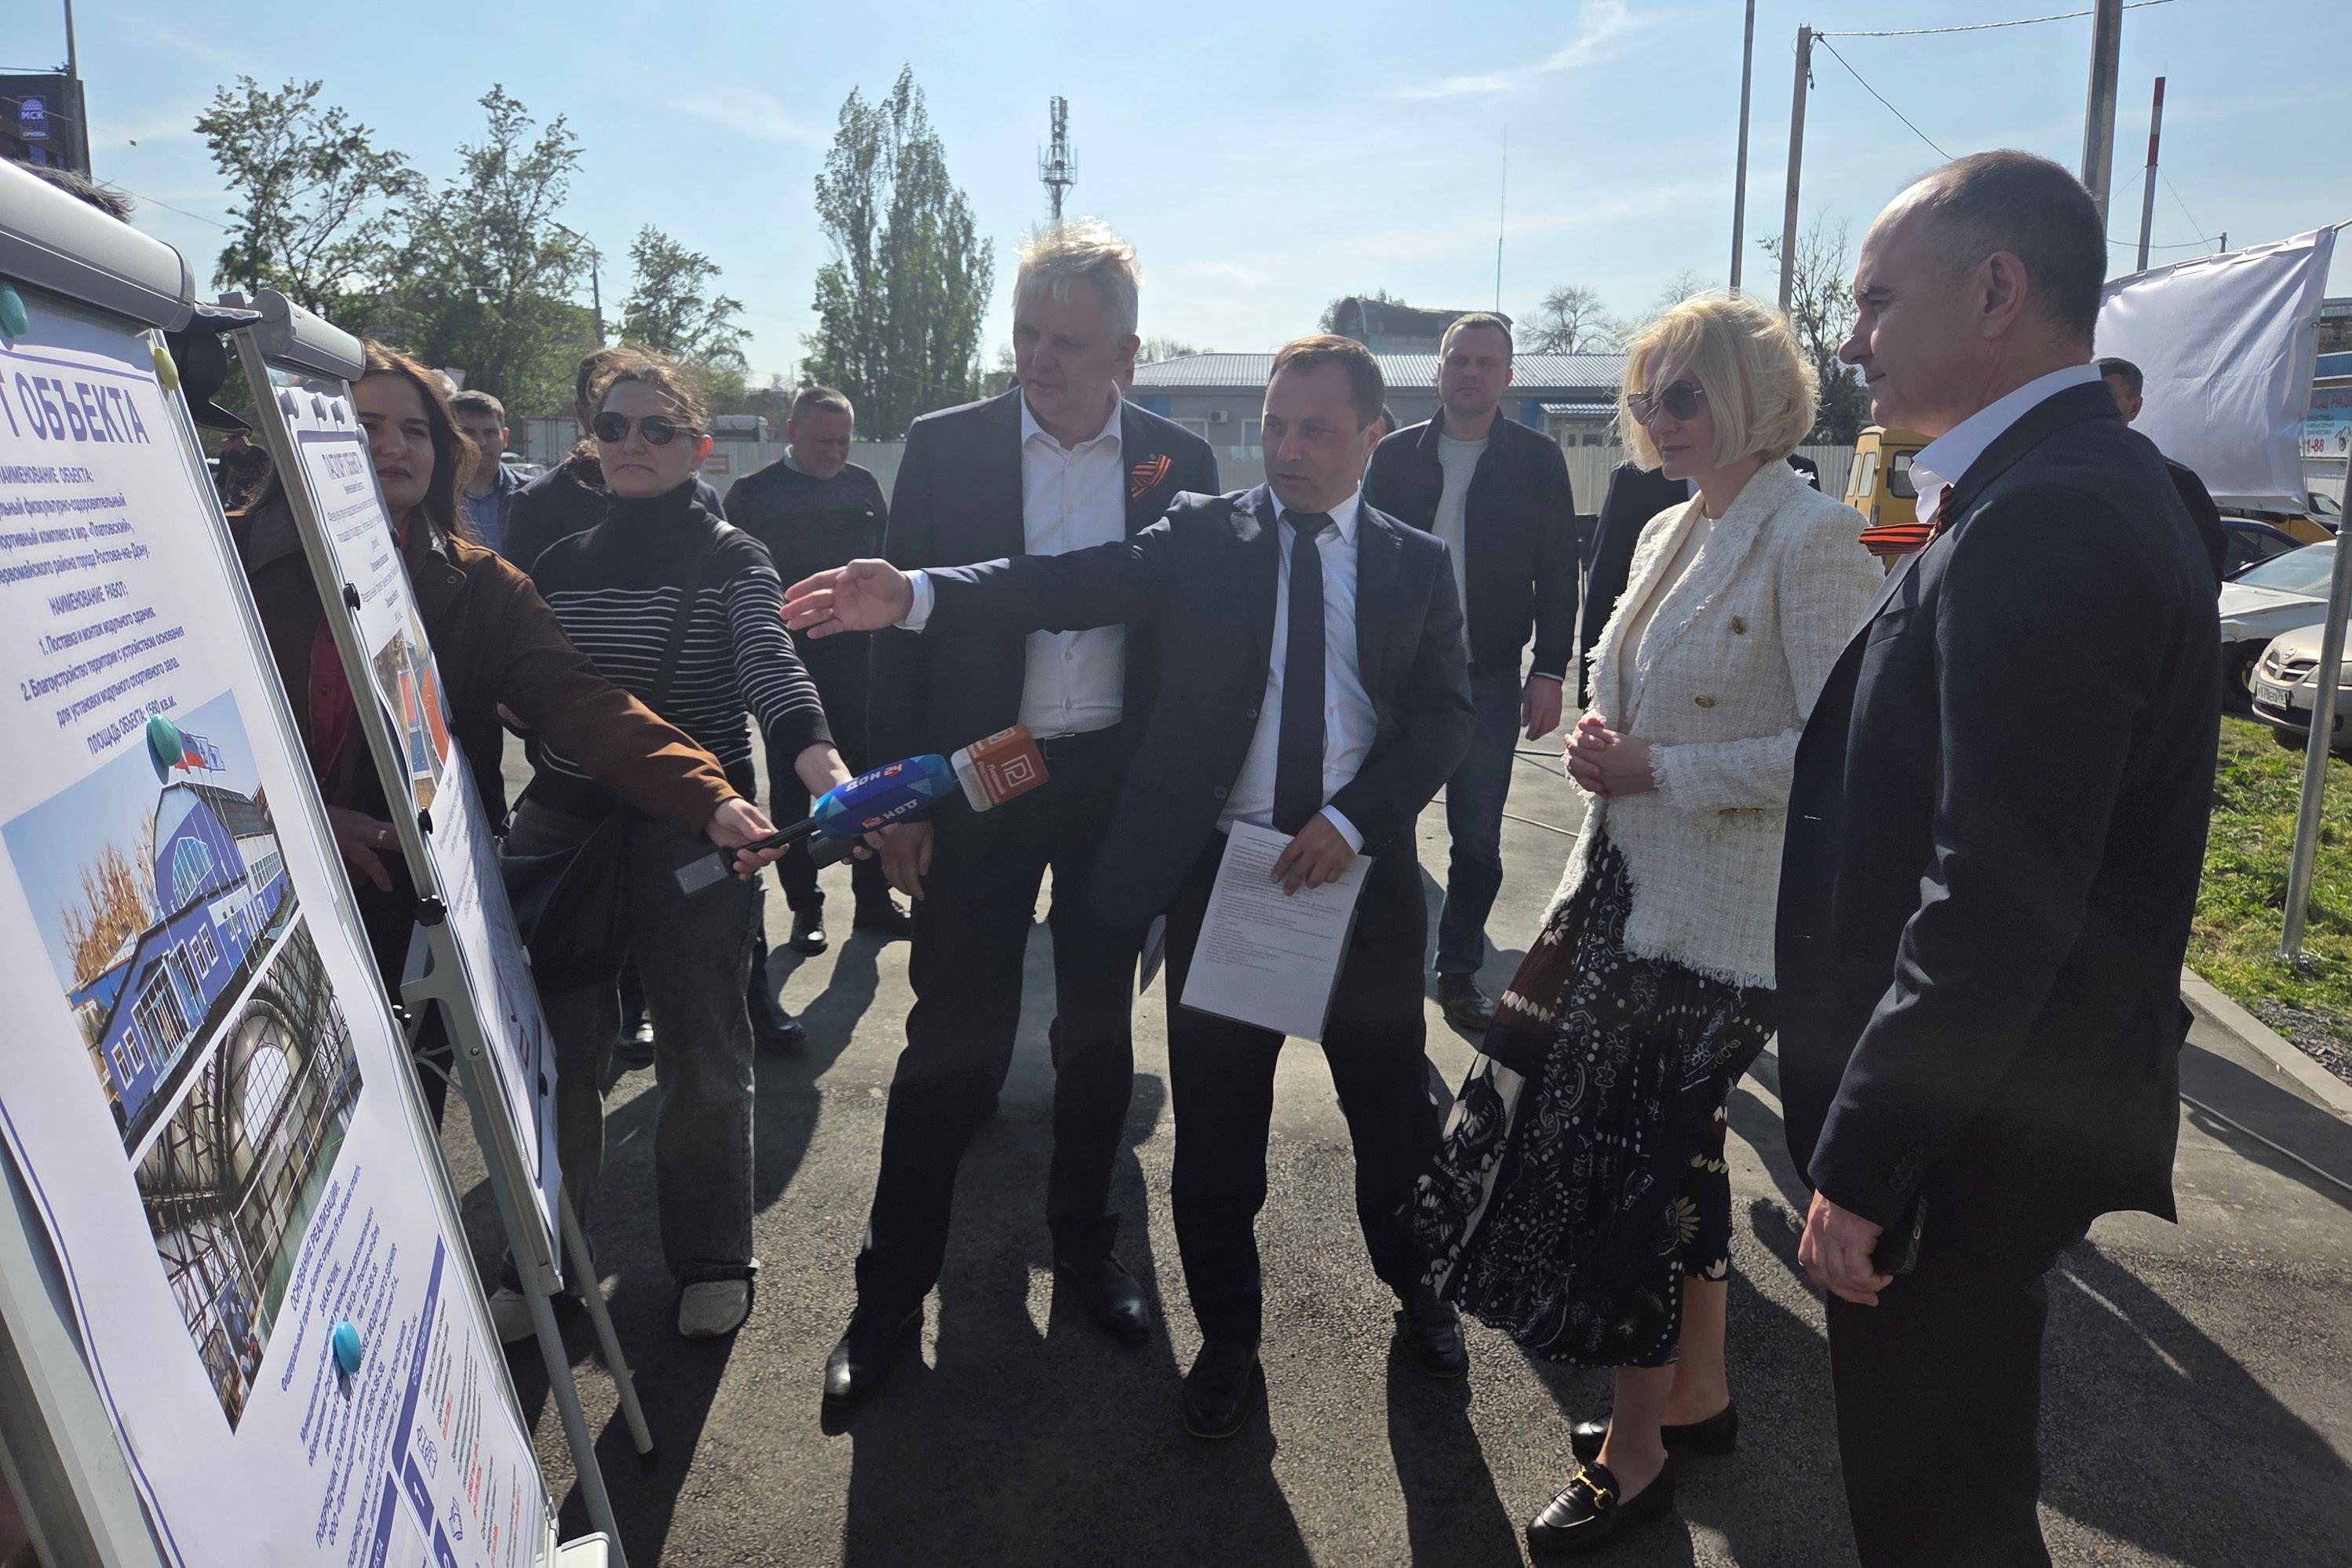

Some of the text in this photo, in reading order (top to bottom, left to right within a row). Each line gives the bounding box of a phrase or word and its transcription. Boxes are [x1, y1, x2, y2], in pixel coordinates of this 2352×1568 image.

[15, 372, 151, 444] ОБЪЕКТА
[53, 555, 78, 578] района
[49, 581, 129, 616] НАИМЕНОВАНИЕ РАБОТ:
[46, 630, 79, 654] Поставка
[28, 663, 89, 698] Благоустройство
[86, 723, 122, 756] ПЛОЩАДЬ
[290, 1241, 313, 1311] ОСНОВАНИЕ
[315, 1462, 339, 1550] ПОДРЯДЧИК
[413, 1481, 425, 1508] 1
[329, 1511, 339, 1546] ООО
